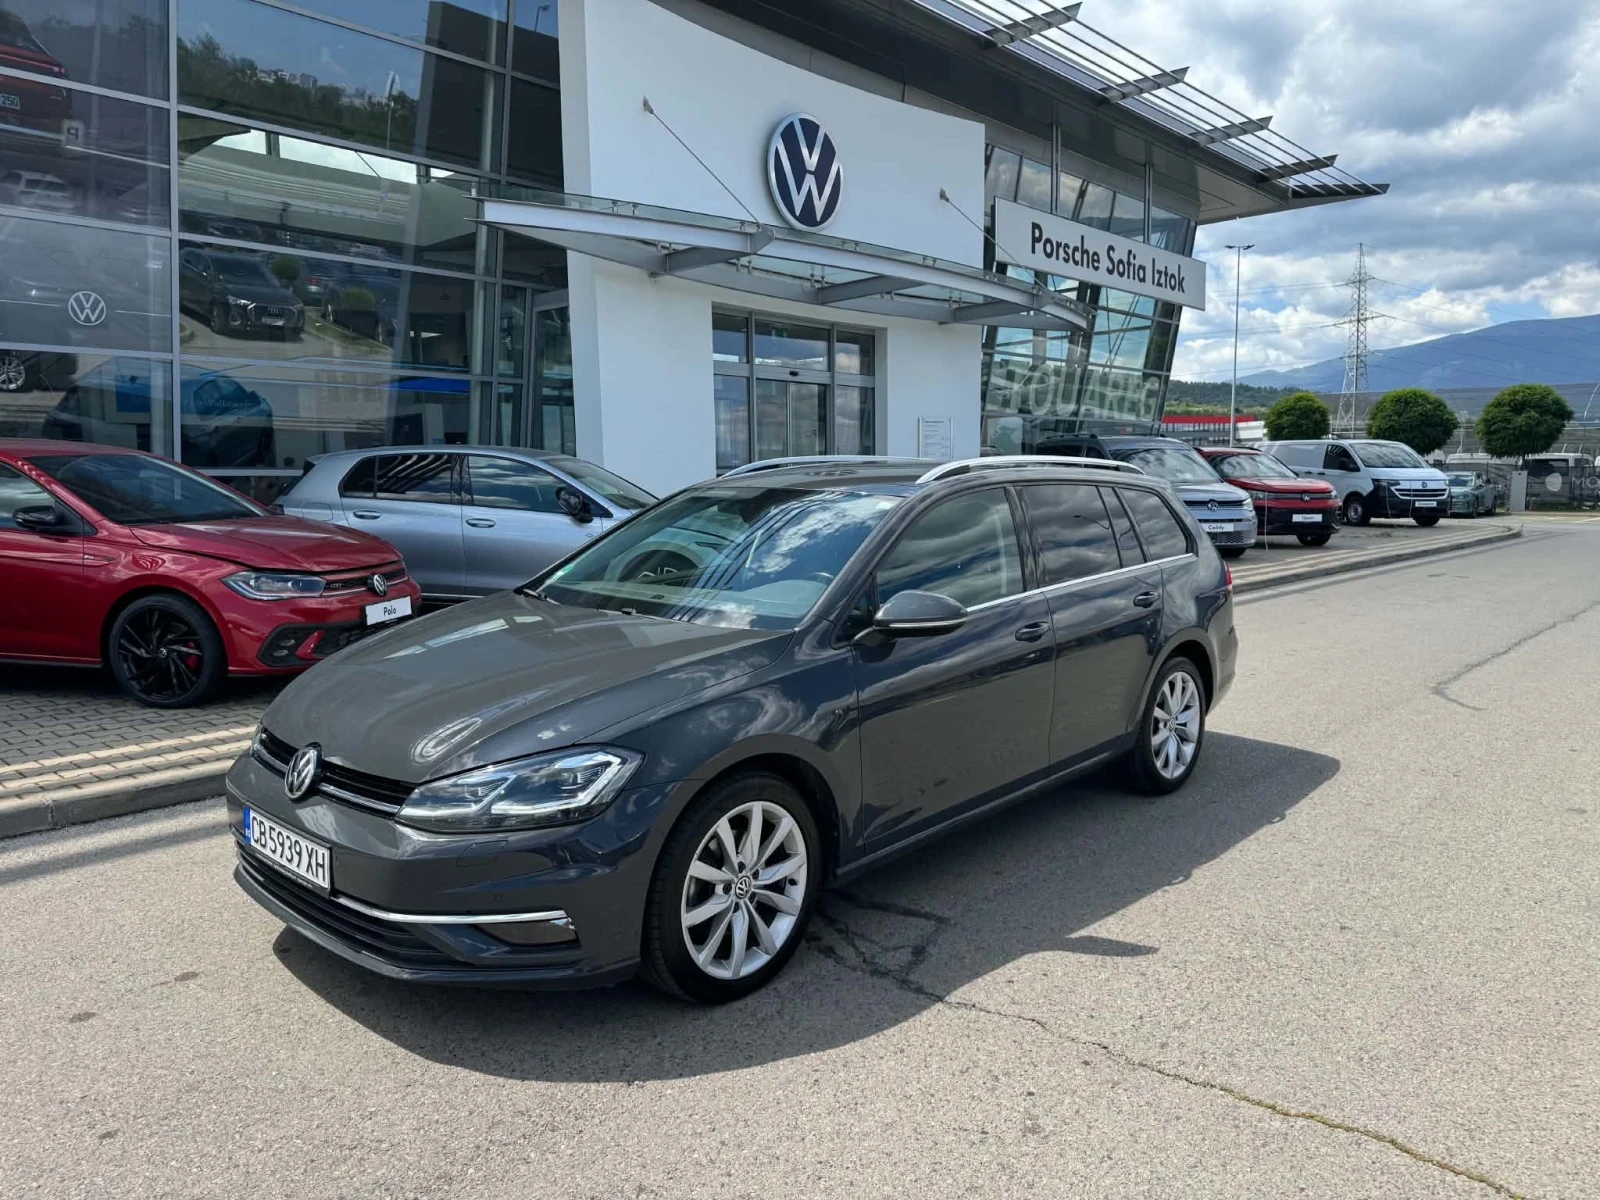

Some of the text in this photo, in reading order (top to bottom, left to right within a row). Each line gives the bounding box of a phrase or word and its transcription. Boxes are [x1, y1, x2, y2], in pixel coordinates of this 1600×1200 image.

[768, 113, 844, 230] VW
[1031, 222, 1185, 293] Porsche Sofia Iztok
[383, 605, 397, 616] Polo
[268, 825, 303, 868] 5939
[305, 844, 326, 881] XH
